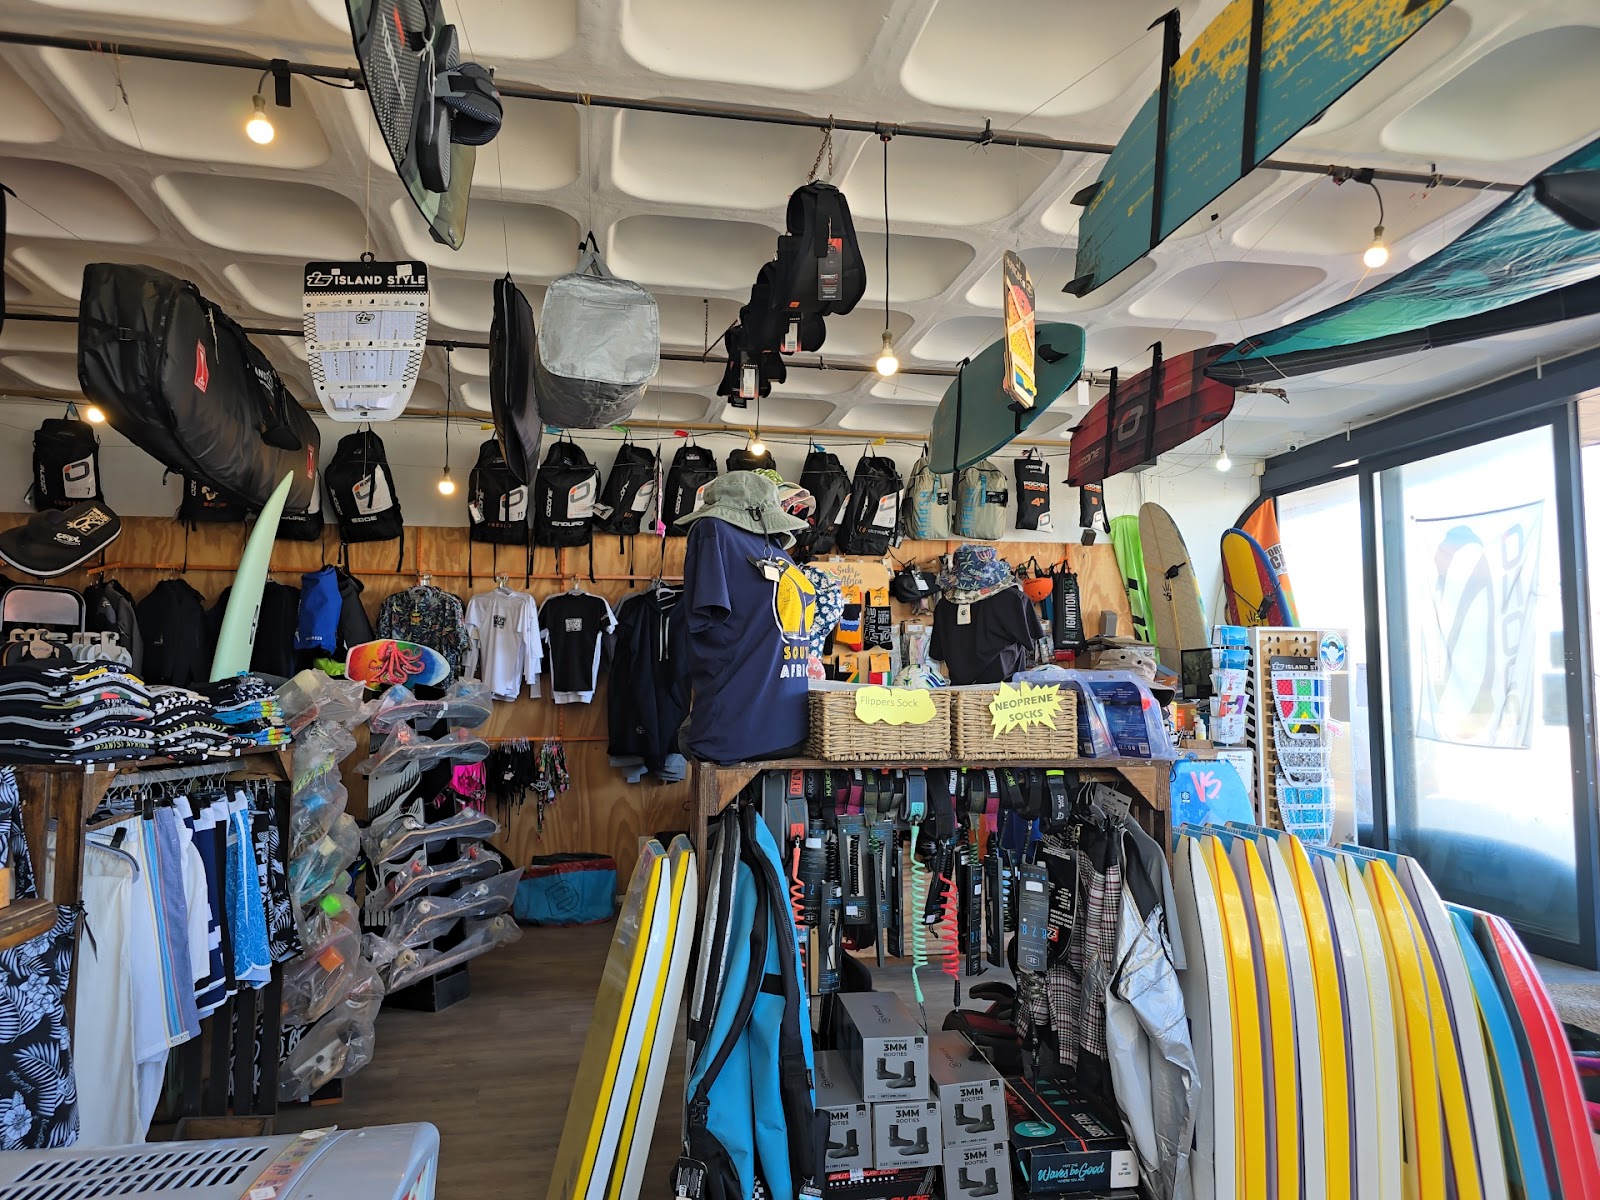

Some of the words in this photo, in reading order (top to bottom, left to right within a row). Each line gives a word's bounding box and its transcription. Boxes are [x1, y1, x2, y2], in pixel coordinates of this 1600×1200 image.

[334, 275, 383, 285] ISLAND
[387, 275, 426, 285] STYLE
[546, 487, 554, 518] OZONE
[674, 485, 684, 515] OZONE
[350, 515, 378, 524] EDGE
[917, 490, 929, 538] AIRUSH
[551, 520, 585, 528] ENDURO
[836, 564, 855, 575] Socks
[840, 575, 863, 587] Africa
[1065, 592, 1077, 629] IGNITION
[783, 646, 809, 660] SOUT
[780, 664, 809, 679] AFRIC
[860, 696, 895, 708] Flippers
[896, 698, 918, 708] Sock
[994, 692, 1054, 712] NEOPRENE
[1008, 708, 1044, 723] SOCKS
[1190, 770, 1222, 802] VS
[883, 1043, 907, 1052] 3MM
[960, 1087, 984, 1097] 3MM
[960, 1095, 984, 1103] BOOTIES
[830, 1111, 849, 1121] MM
[896, 1109, 920, 1118] 3MM
[964, 1151, 988, 1160] 3MM
[1037, 1165, 1069, 1182] Waves
[1069, 1164, 1079, 1176] be
[1078, 1162, 1105, 1179] Good
